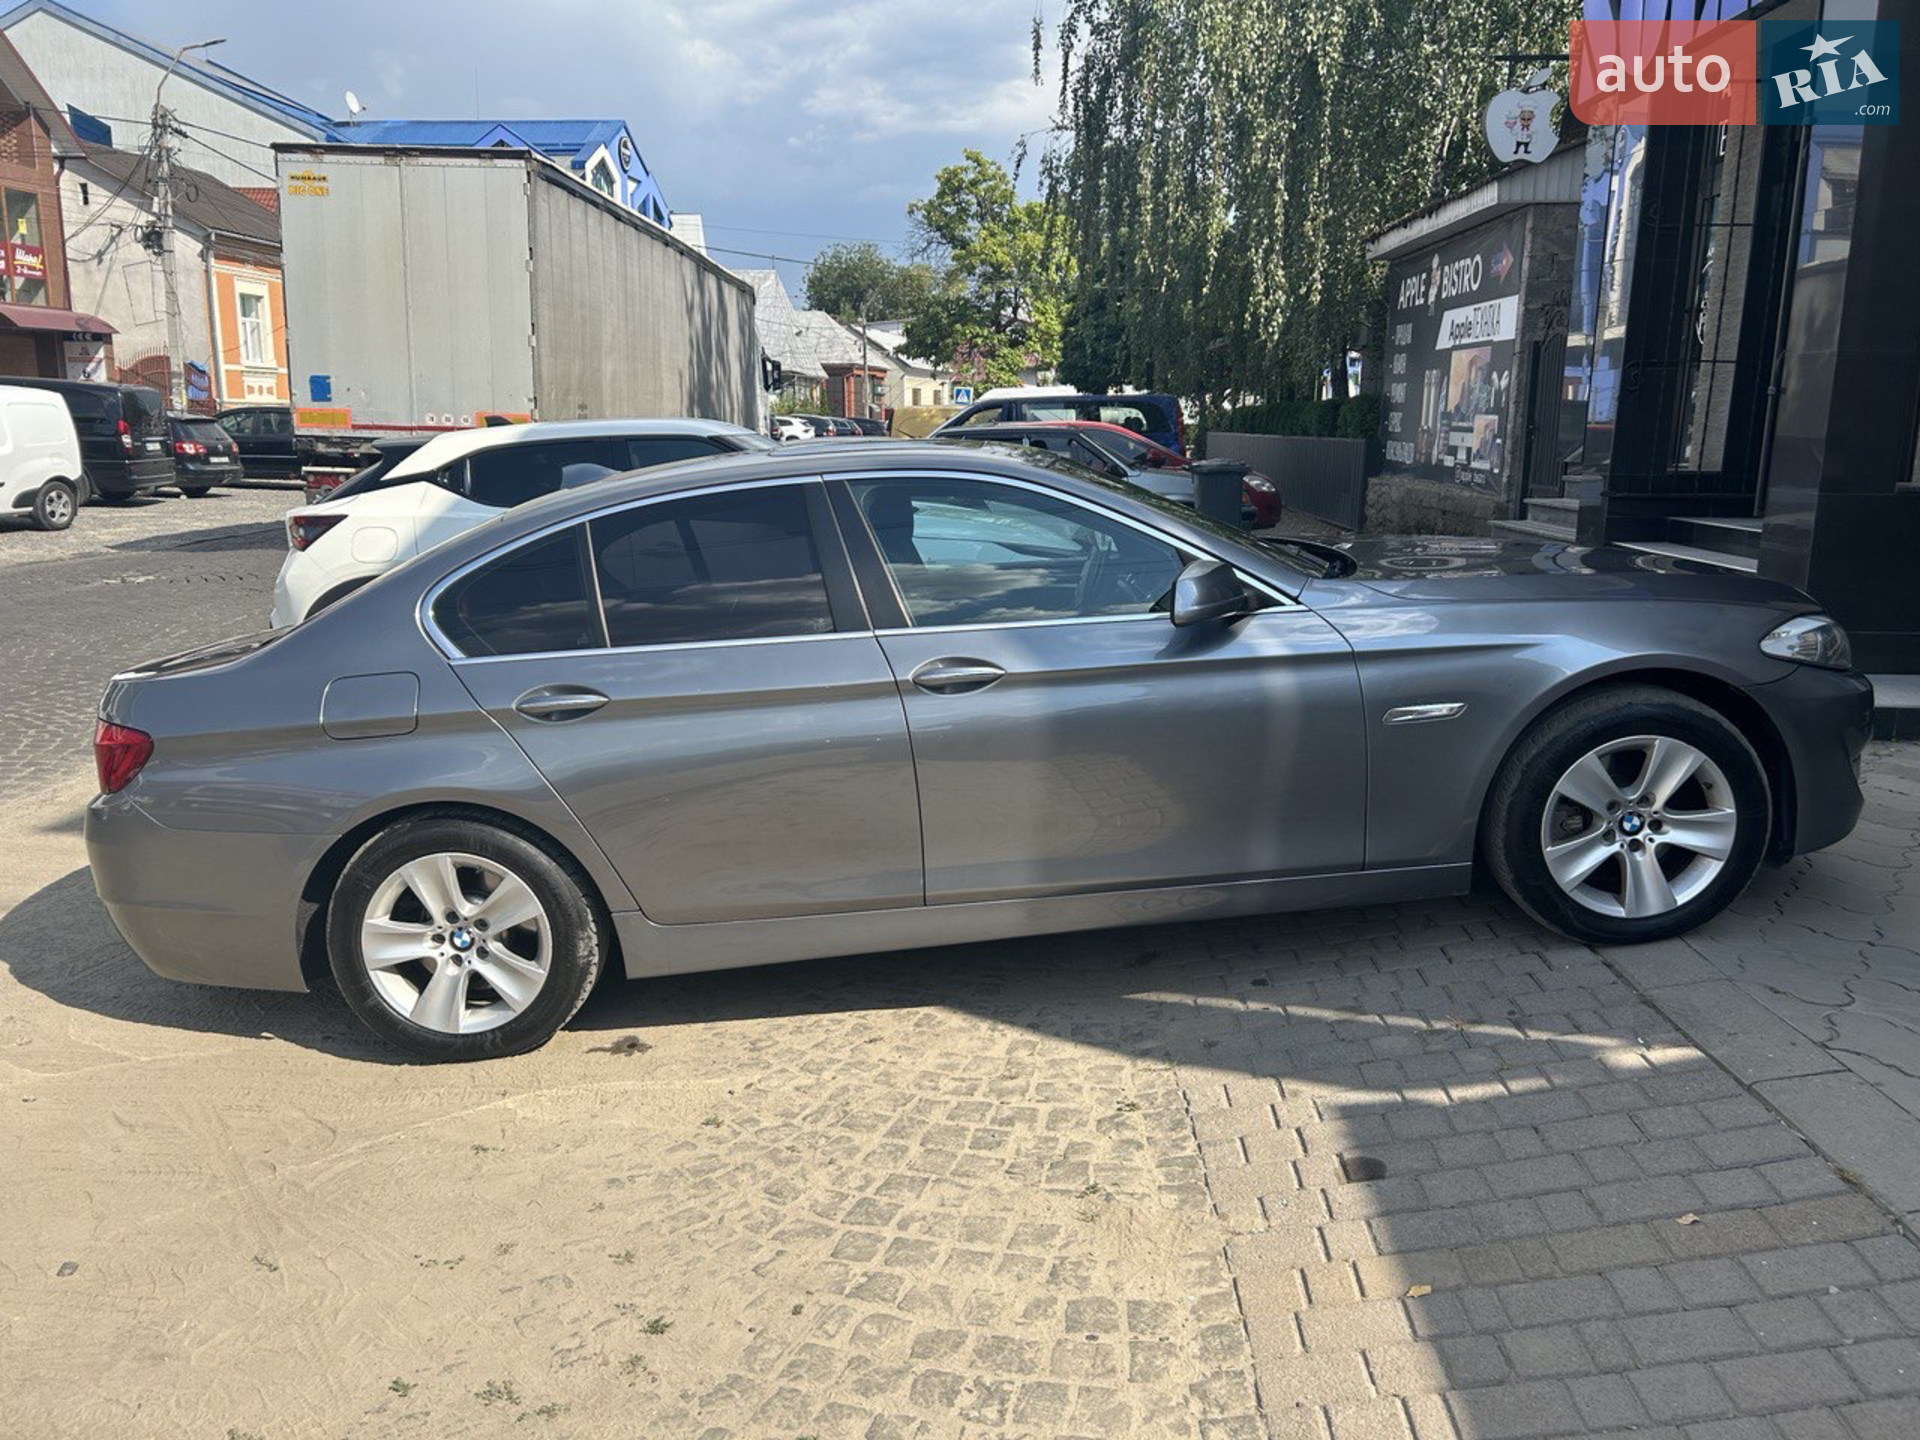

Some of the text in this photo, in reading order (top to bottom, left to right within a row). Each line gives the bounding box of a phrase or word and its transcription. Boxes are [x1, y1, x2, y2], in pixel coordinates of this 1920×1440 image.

[309, 186, 329, 196] ONE
[1398, 272, 1427, 310] APPLE
[1442, 254, 1482, 299] BISTRO
